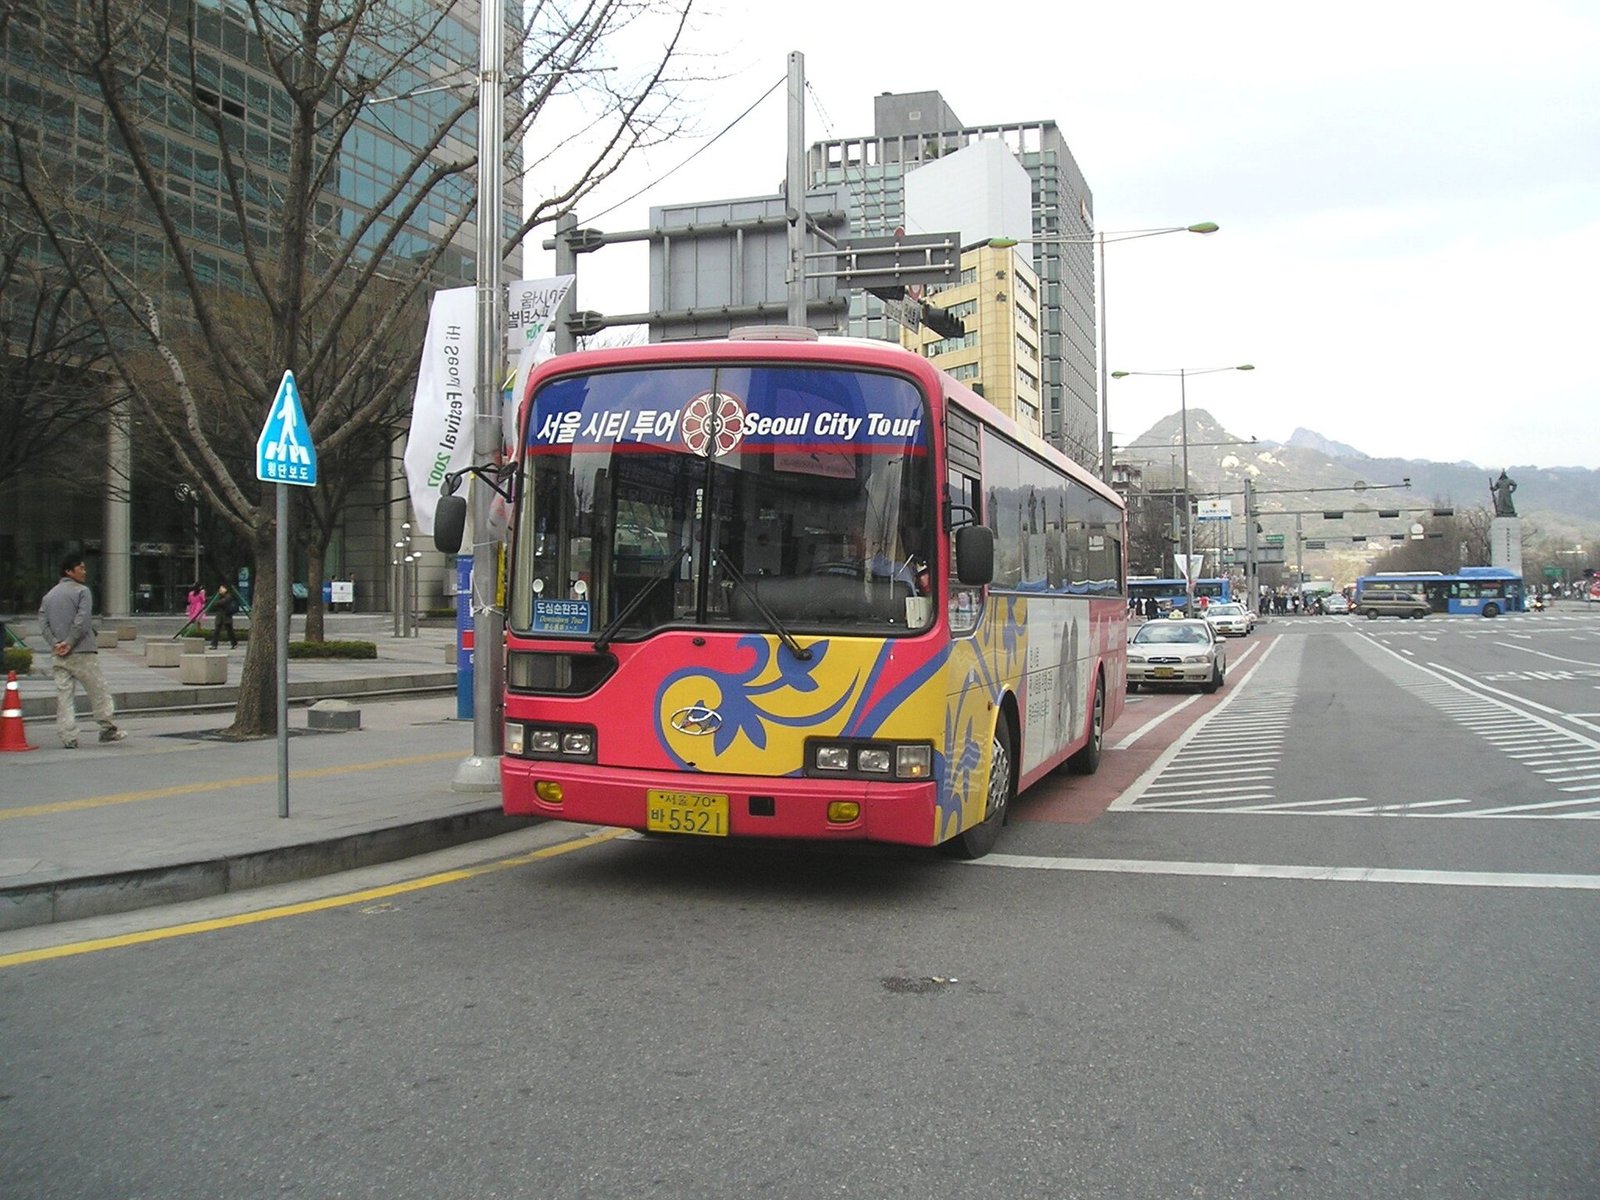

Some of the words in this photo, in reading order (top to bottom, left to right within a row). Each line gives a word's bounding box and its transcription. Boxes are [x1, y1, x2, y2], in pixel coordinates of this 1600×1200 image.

[536, 411, 582, 444] 서울
[582, 410, 630, 443] 시티
[630, 409, 681, 443] 투어
[742, 412, 811, 437] Seoul
[814, 412, 862, 440] City
[867, 413, 921, 437] Tour
[267, 462, 308, 479] 횡단보도
[692, 796, 711, 807] 70
[651, 808, 665, 823] 바
[669, 808, 720, 834] 5521
